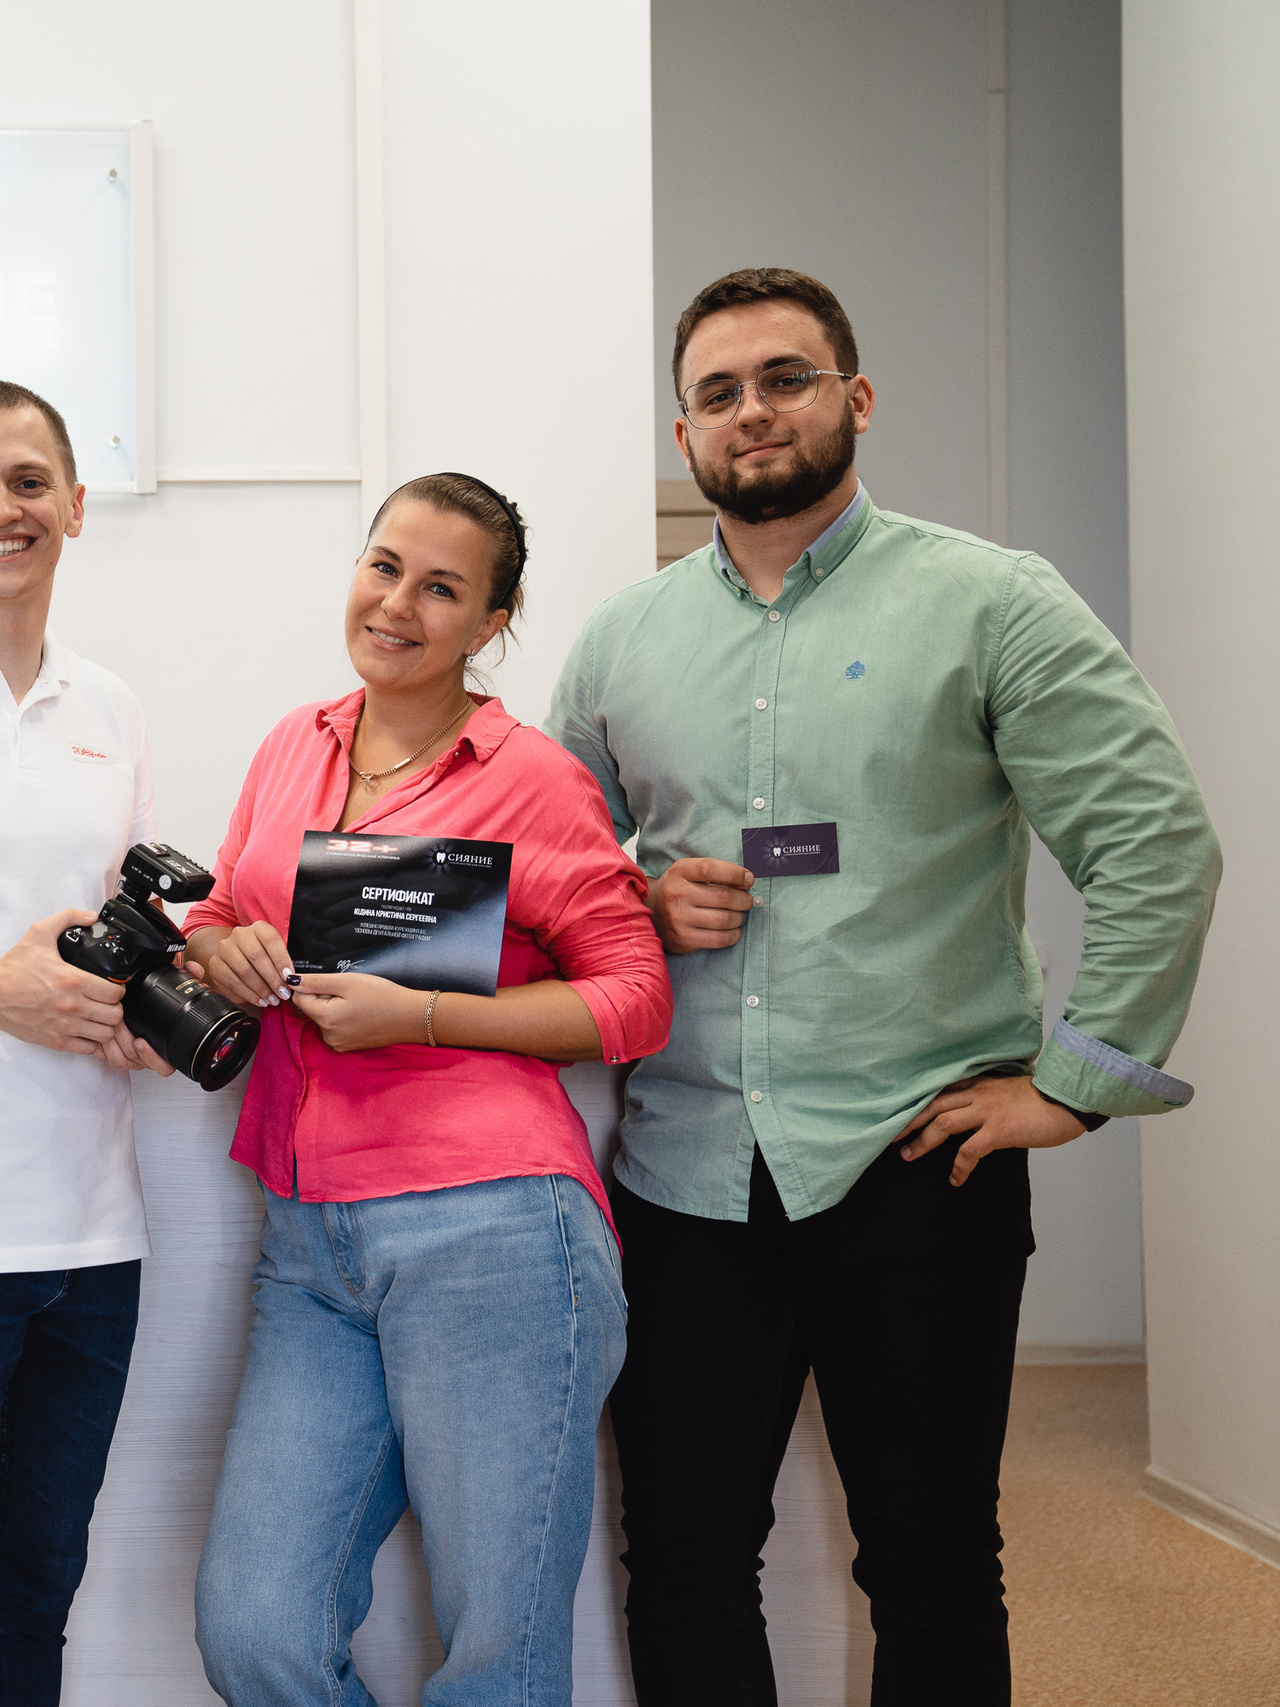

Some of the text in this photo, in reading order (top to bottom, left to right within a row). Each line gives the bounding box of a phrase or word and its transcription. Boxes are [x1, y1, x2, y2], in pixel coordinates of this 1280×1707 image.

[326, 839, 398, 853] 32+
[783, 845, 821, 853] СИЯНИЕ
[325, 851, 378, 859] СТОМАТОЛОГИЧЕСКАЯ
[447, 853, 493, 865] СИЯНИЕ
[361, 886, 435, 906] СЕРТИФИКАТ
[354, 908, 437, 923] ЮДИНА КРИСТИНА СЕРГЕЕВНА
[166, 944, 186, 952] Nikon
